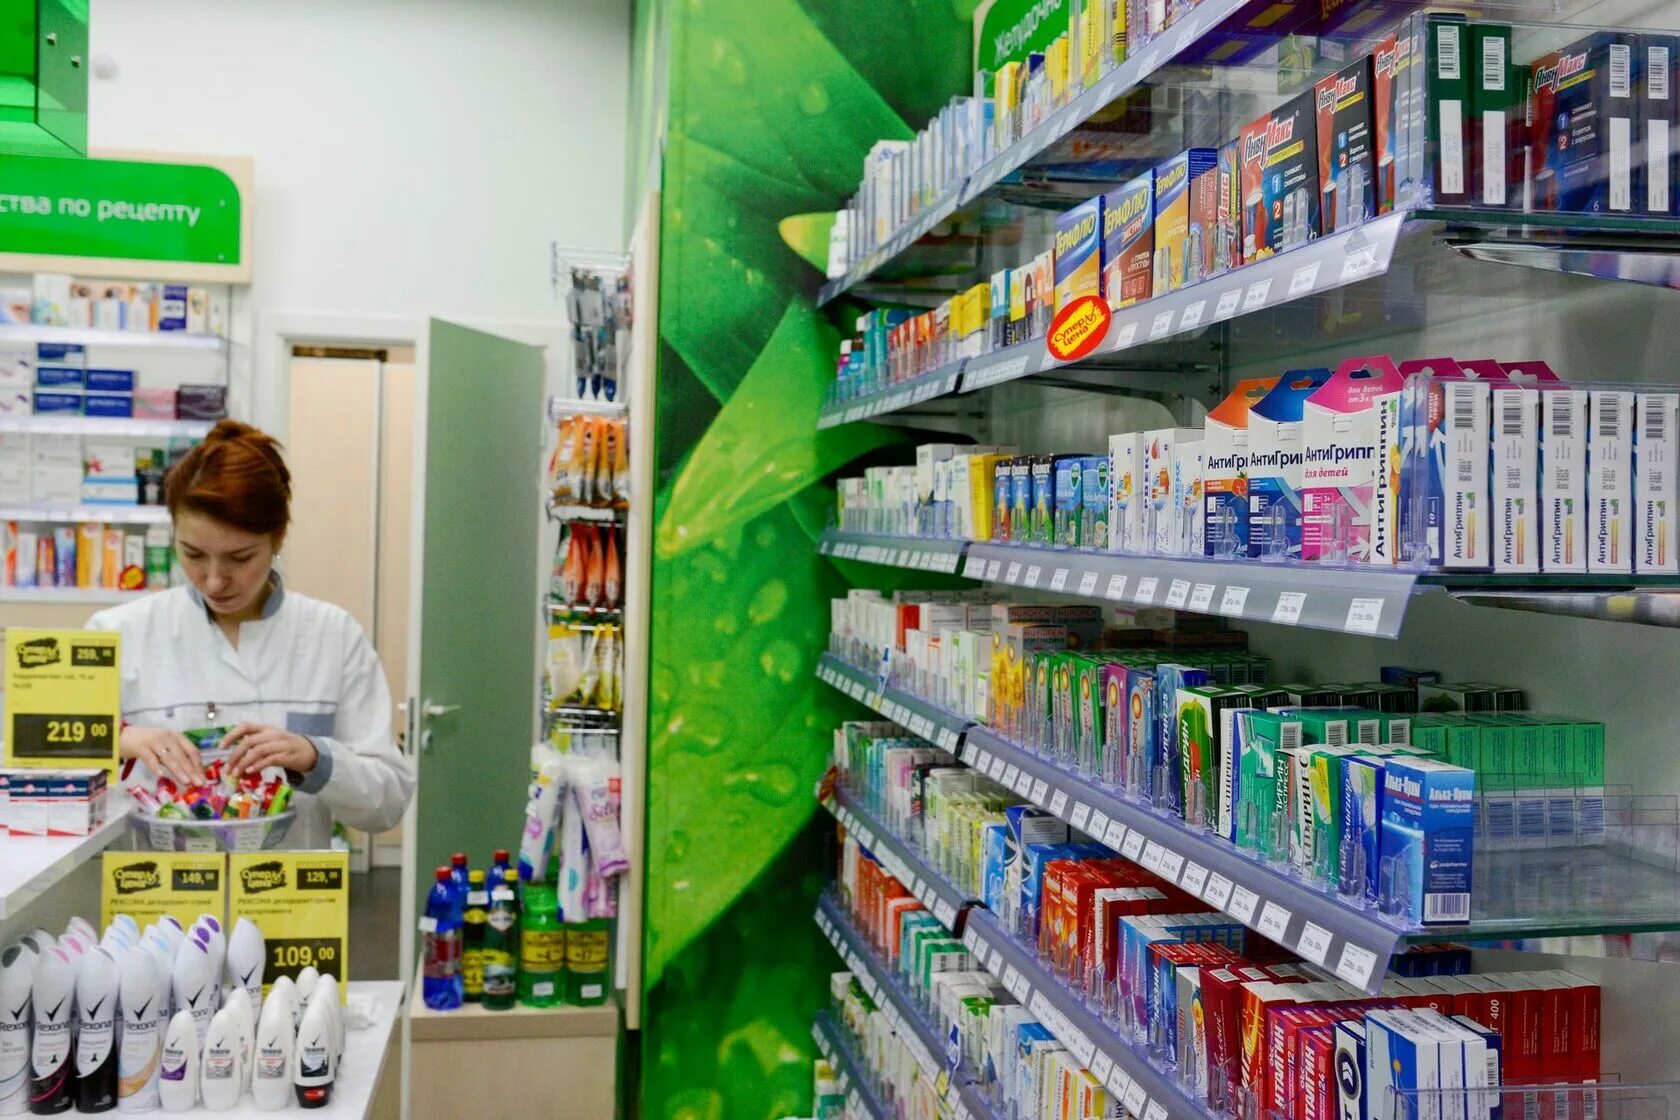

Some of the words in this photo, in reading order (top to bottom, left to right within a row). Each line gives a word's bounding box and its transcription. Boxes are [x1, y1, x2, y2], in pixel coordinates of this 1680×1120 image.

[58, 198, 91, 217] по
[97, 200, 201, 227] рецепту
[1055, 318, 1085, 342] Супер
[1063, 325, 1089, 347] цена
[1318, 466, 1348, 478] детей
[1375, 400, 1388, 558] АнтиГриппин
[1453, 491, 1465, 559] АнтиГриппин
[1503, 497, 1514, 565] АнтиГриппин
[1552, 498, 1563, 564] АнтиГриппин
[1597, 497, 1608, 564] АнтиГриппин
[1644, 500, 1655, 566] АнтиГриппин
[46, 721, 86, 743] 219
[90, 723, 107, 737] 00
[274, 946, 318, 969] 109,
[318, 947, 335, 960] 00
[1490, 999, 1500, 1020] 400
[1274, 1023, 1285, 1110] НТАЛГИН
[1305, 1044, 1315, 1120] ТАЛГИН
